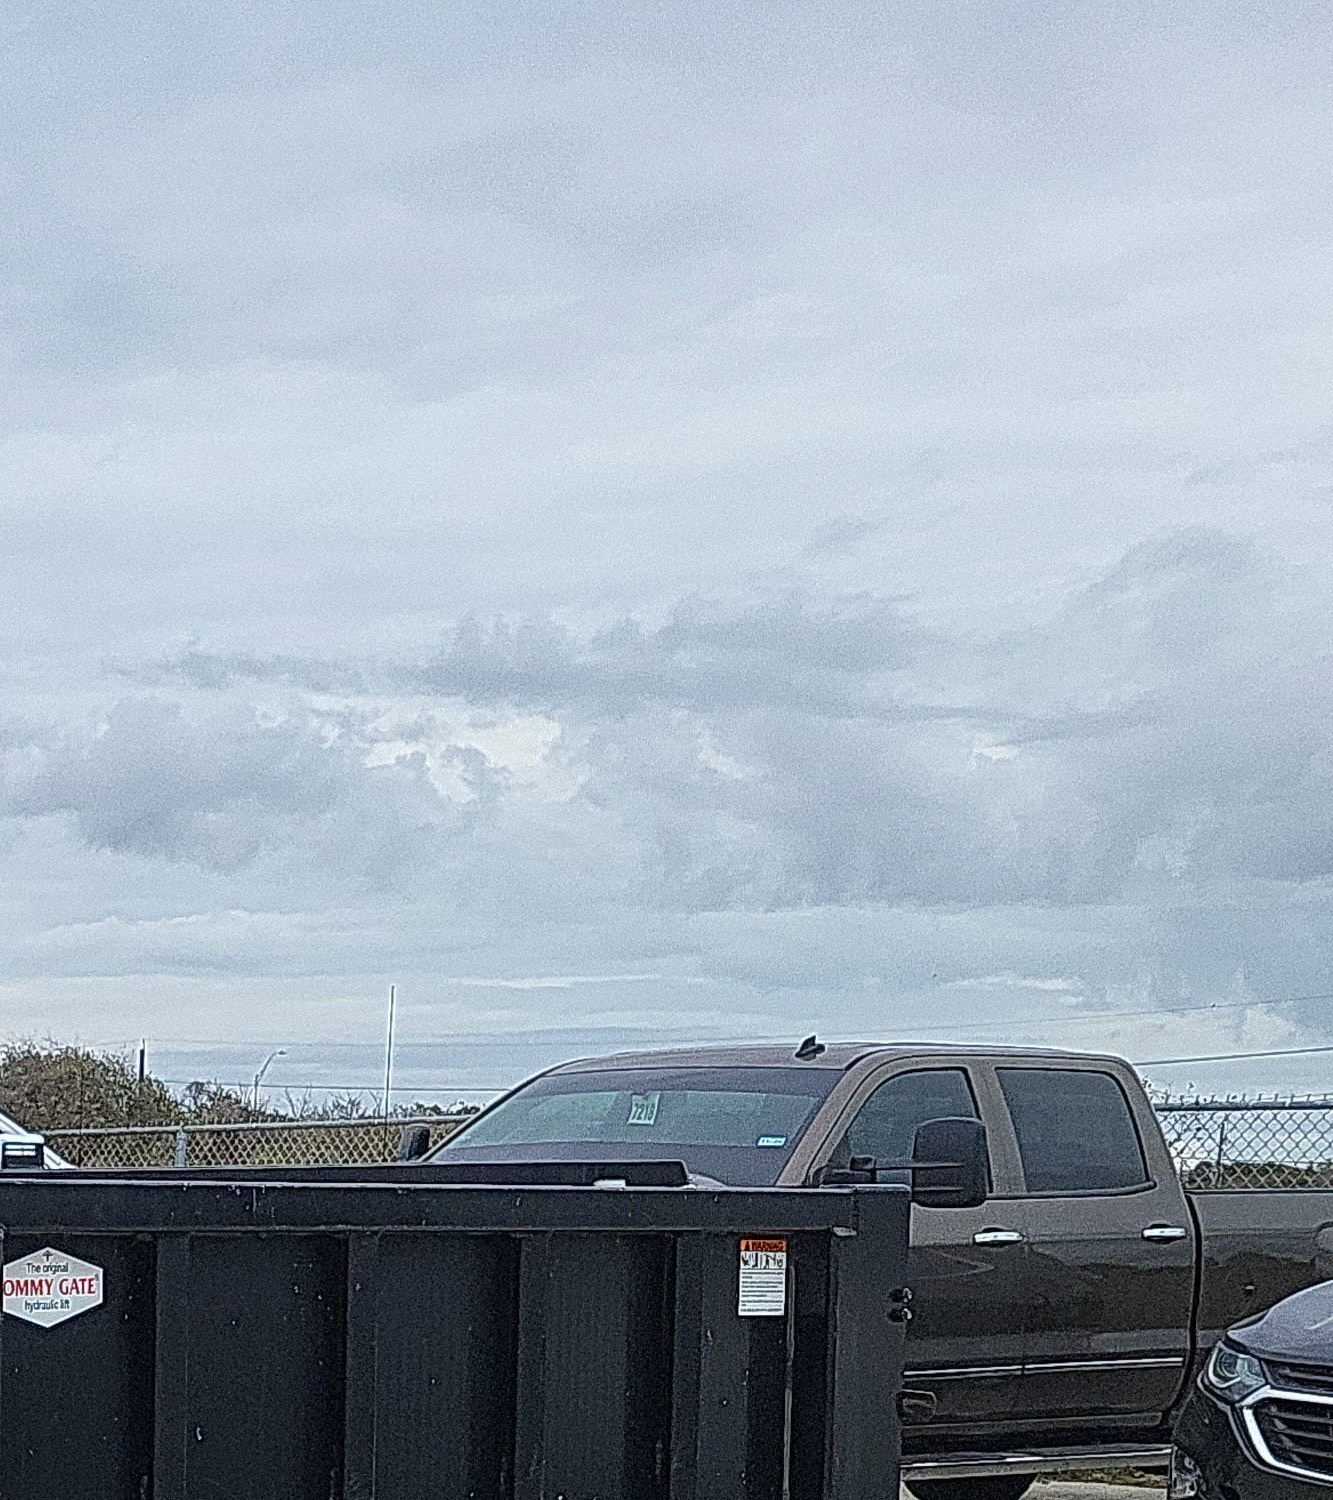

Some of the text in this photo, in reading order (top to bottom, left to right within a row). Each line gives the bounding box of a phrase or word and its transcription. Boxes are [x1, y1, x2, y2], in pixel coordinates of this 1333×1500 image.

[26, 1263, 69, 1275] The original
[2, 1279, 53, 1296] OMMY
[24, 1300, 59, 1313] hydraulic
